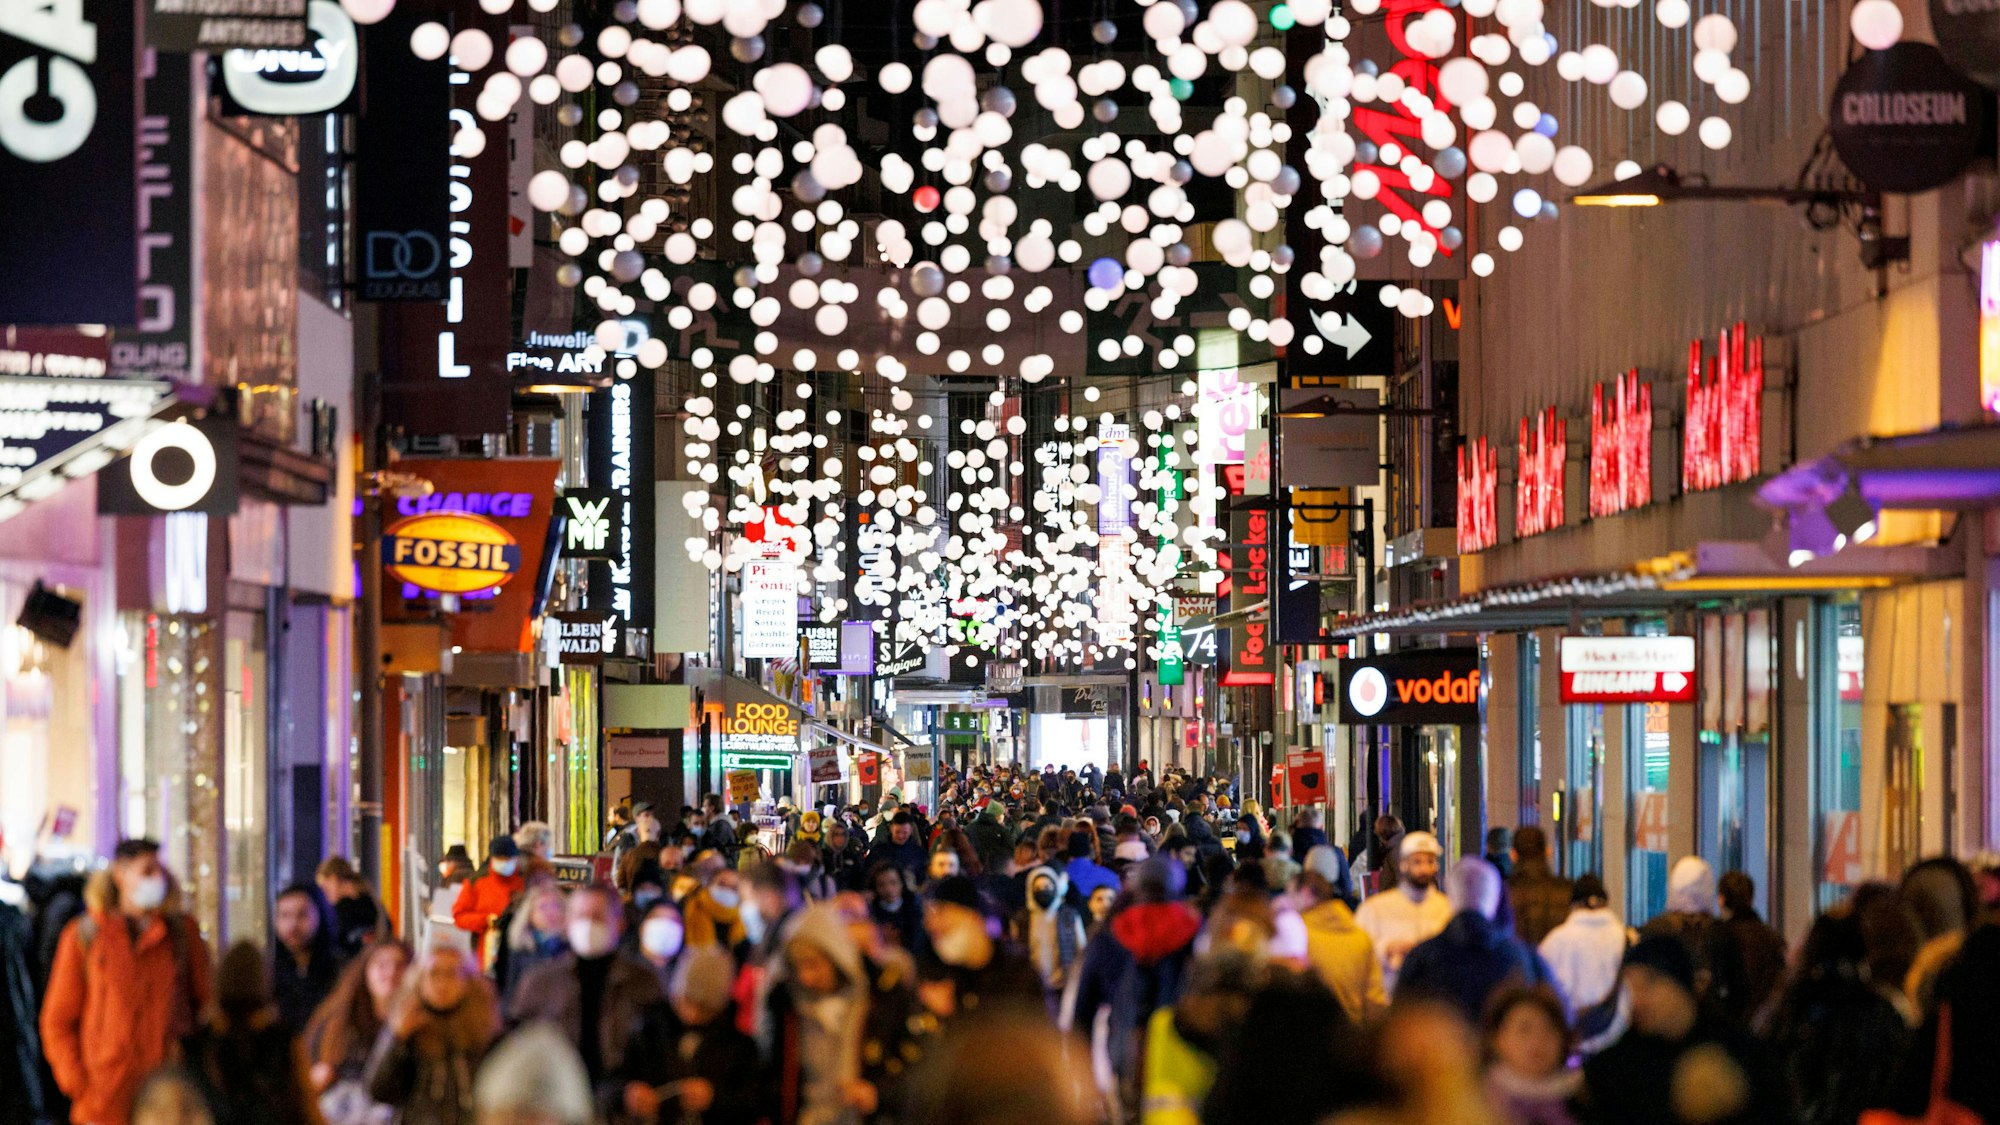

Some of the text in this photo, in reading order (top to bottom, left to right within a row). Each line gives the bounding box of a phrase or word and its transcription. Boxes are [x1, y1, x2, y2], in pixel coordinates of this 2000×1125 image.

[199, 19, 306, 45] ANTIQUES
[1842, 92, 1966, 125] COLLOSEUM
[395, 538, 510, 571] FOSSIL
[559, 623, 601, 637] LBEN
[736, 703, 789, 720] FOOD
[726, 718, 798, 735] LOUNGE
